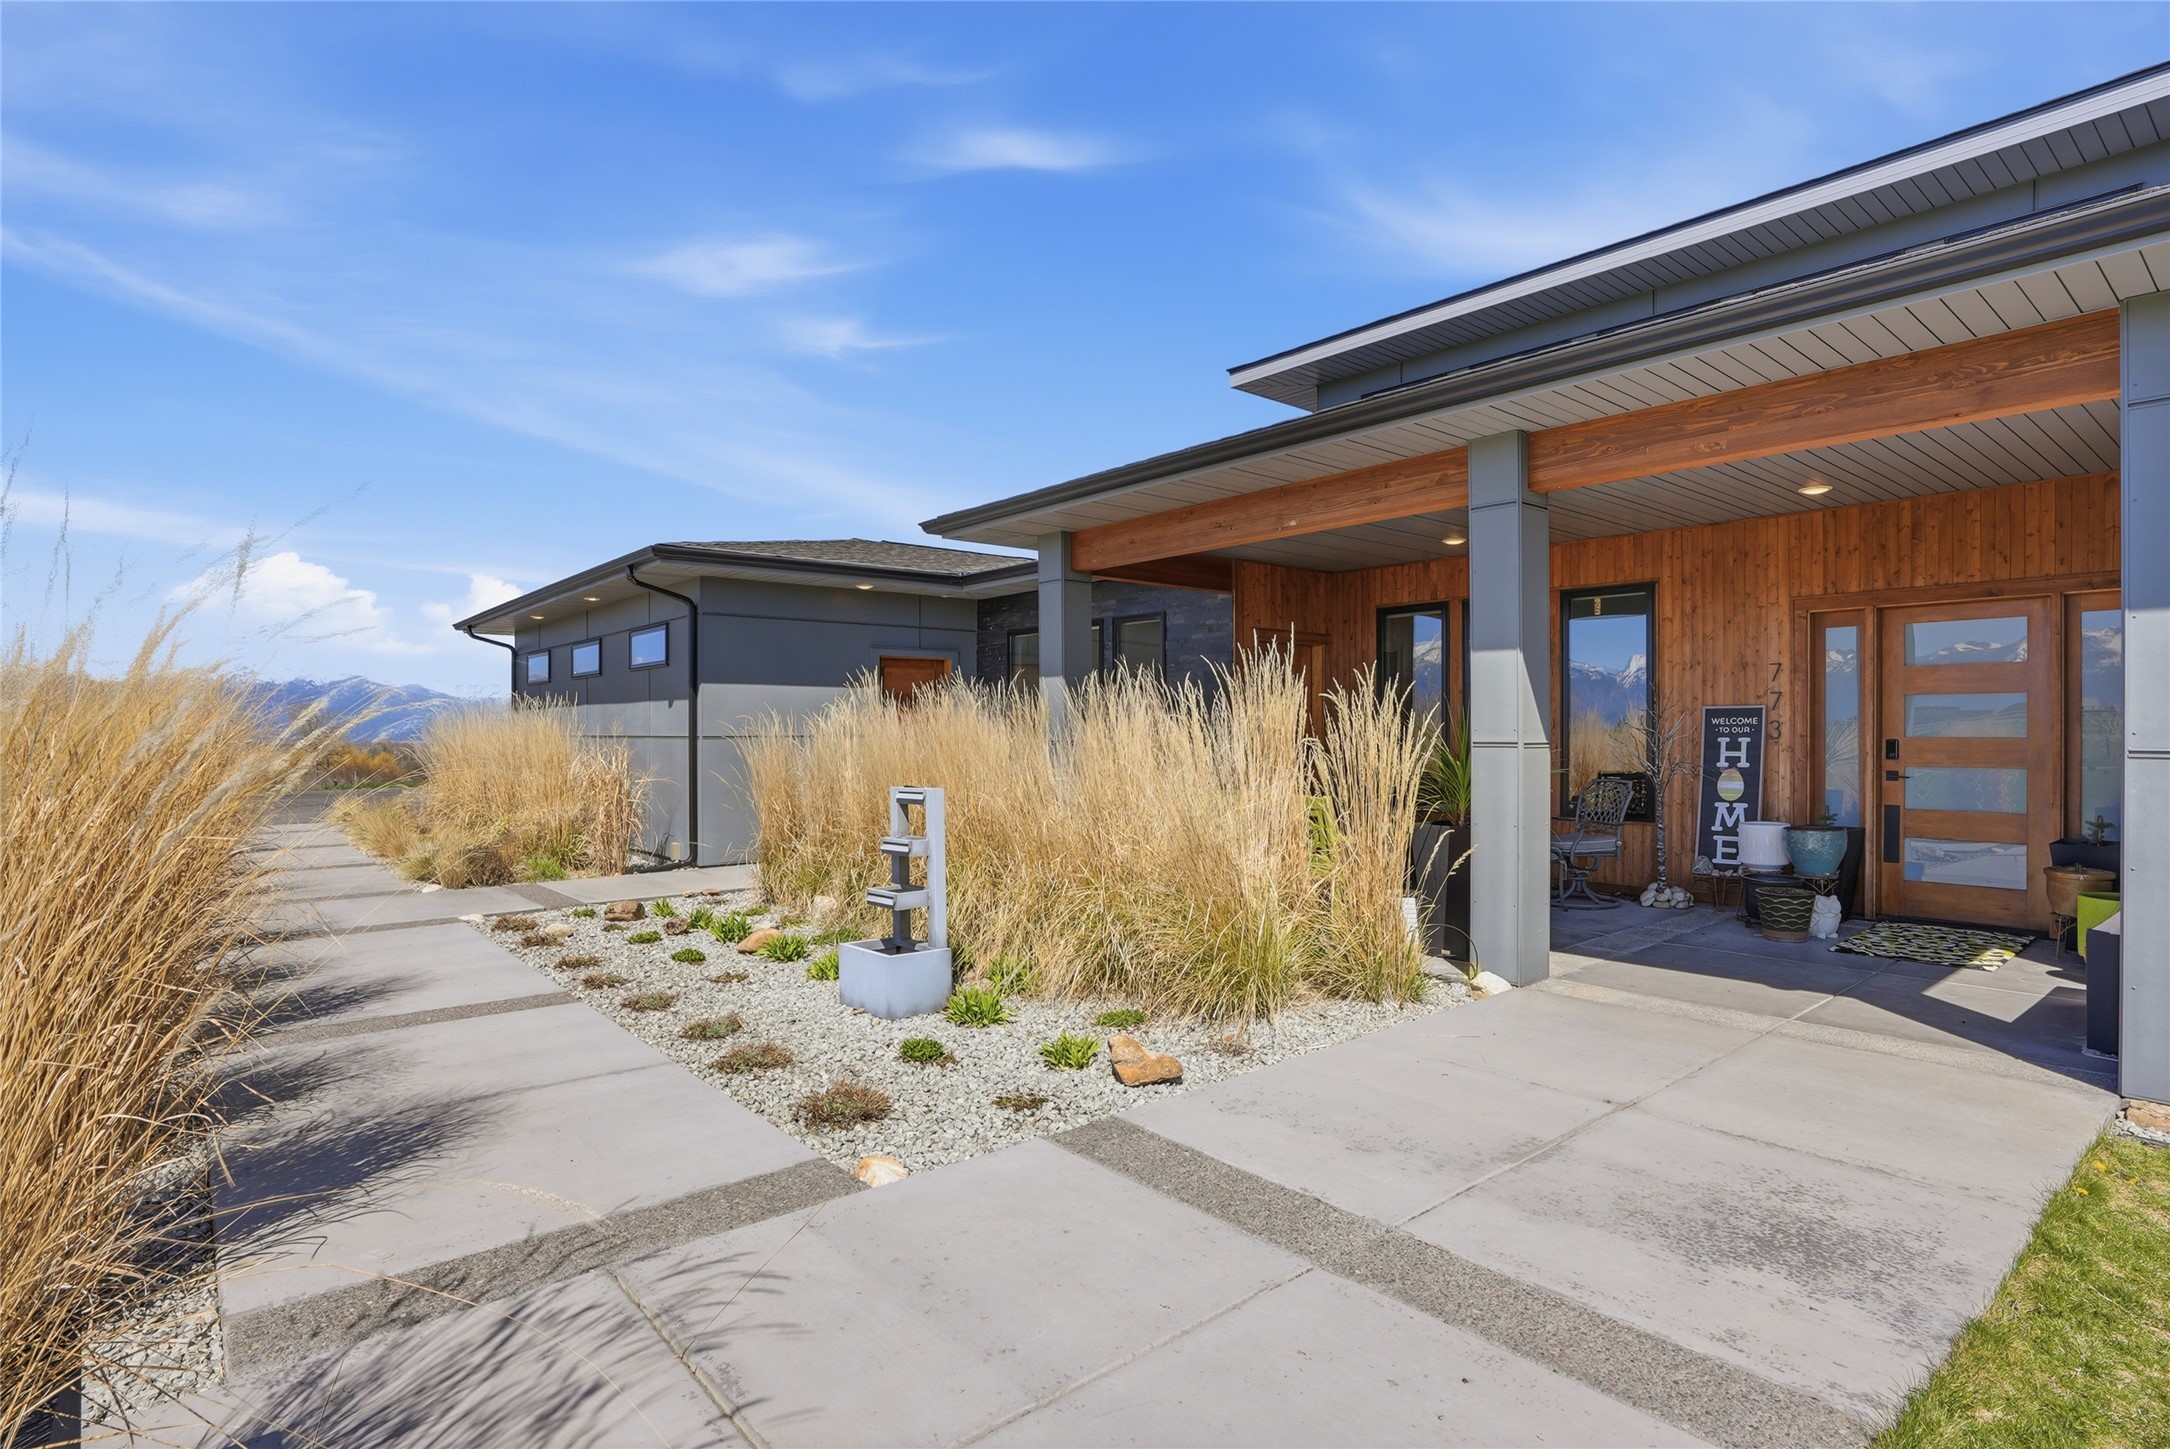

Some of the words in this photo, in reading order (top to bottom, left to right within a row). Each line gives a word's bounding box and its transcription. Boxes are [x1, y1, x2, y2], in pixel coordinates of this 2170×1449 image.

[1769, 662, 1783, 741] 773
[1711, 717, 1758, 725] WELCOME
[1719, 726, 1730, 734] TO
[1732, 726, 1750, 734] OUR
